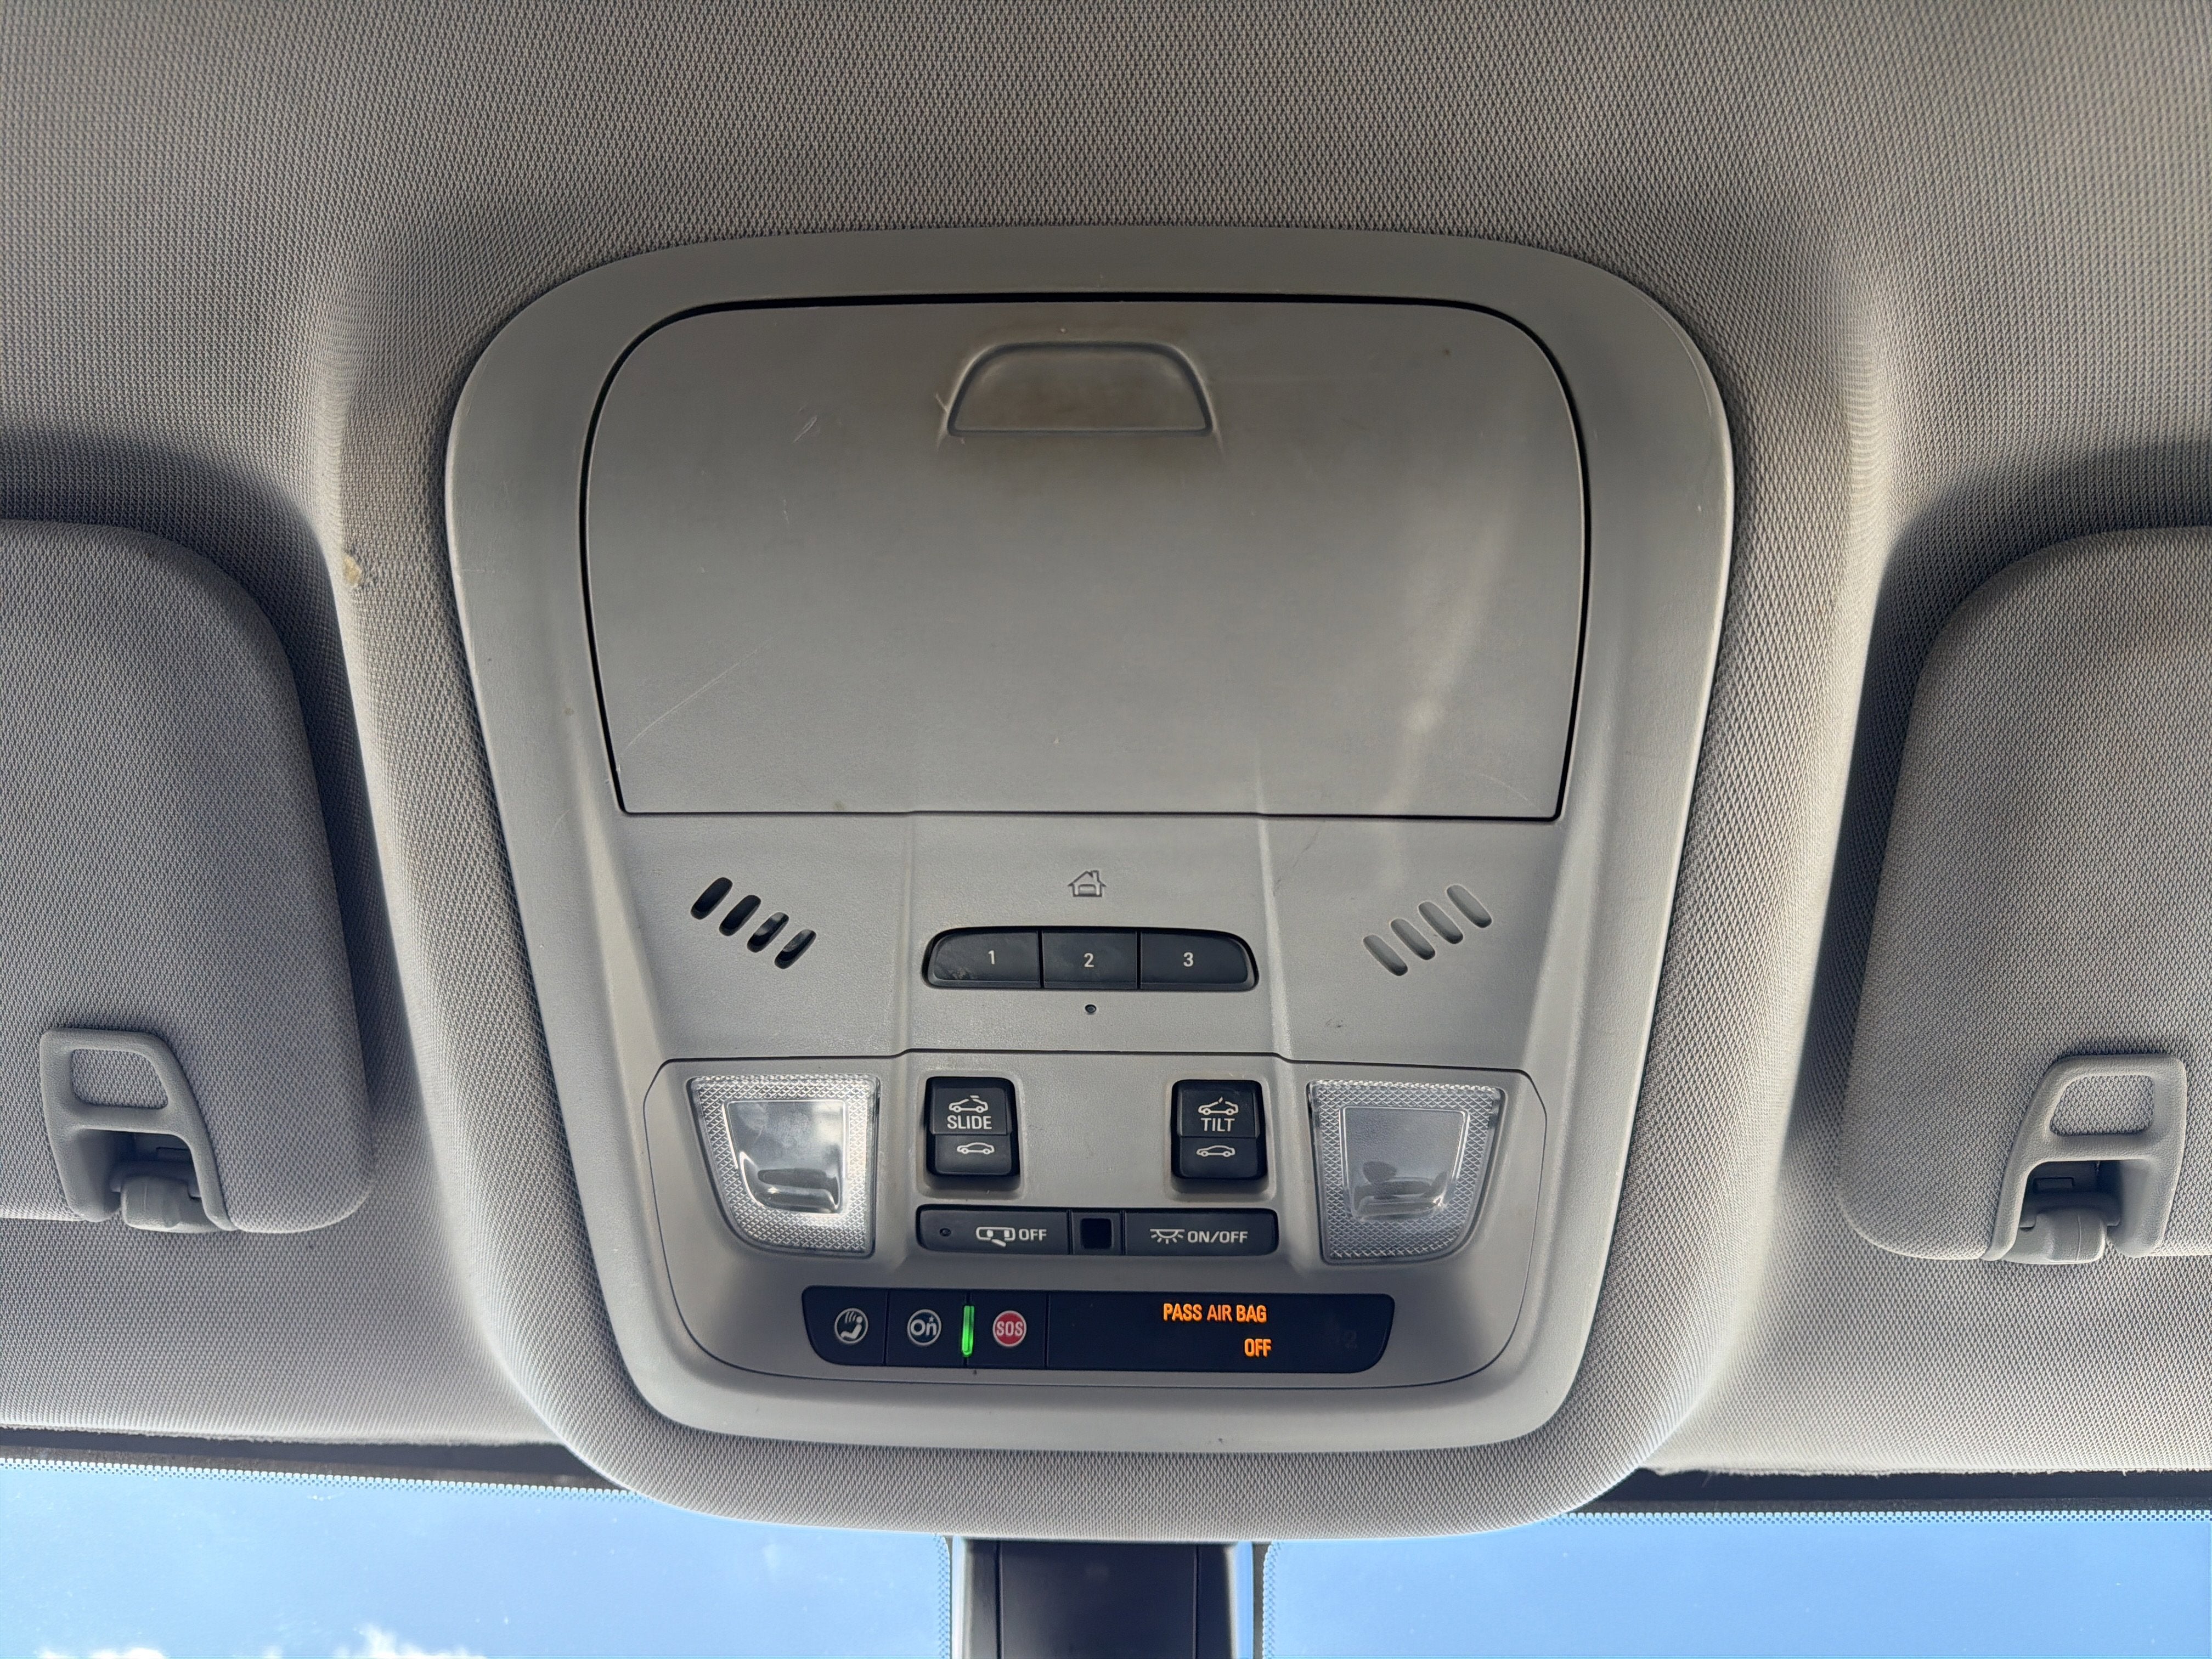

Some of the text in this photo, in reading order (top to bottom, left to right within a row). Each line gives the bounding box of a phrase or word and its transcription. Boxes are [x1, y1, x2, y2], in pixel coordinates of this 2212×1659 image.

[988, 950, 995, 964] 1
[1084, 952, 1094, 967] 2
[1183, 952, 1194, 967] 3
[946, 1115, 992, 1130] SLIDE
[1200, 1117, 1235, 1132] TILT
[1018, 1228, 1047, 1242] OFF
[1187, 1230, 1249, 1244] ON/OFF
[1163, 1303, 1267, 1323] PASS AIR BAG
[996, 1321, 1024, 1337] SOS
[1244, 1338, 1272, 1357] OFF
